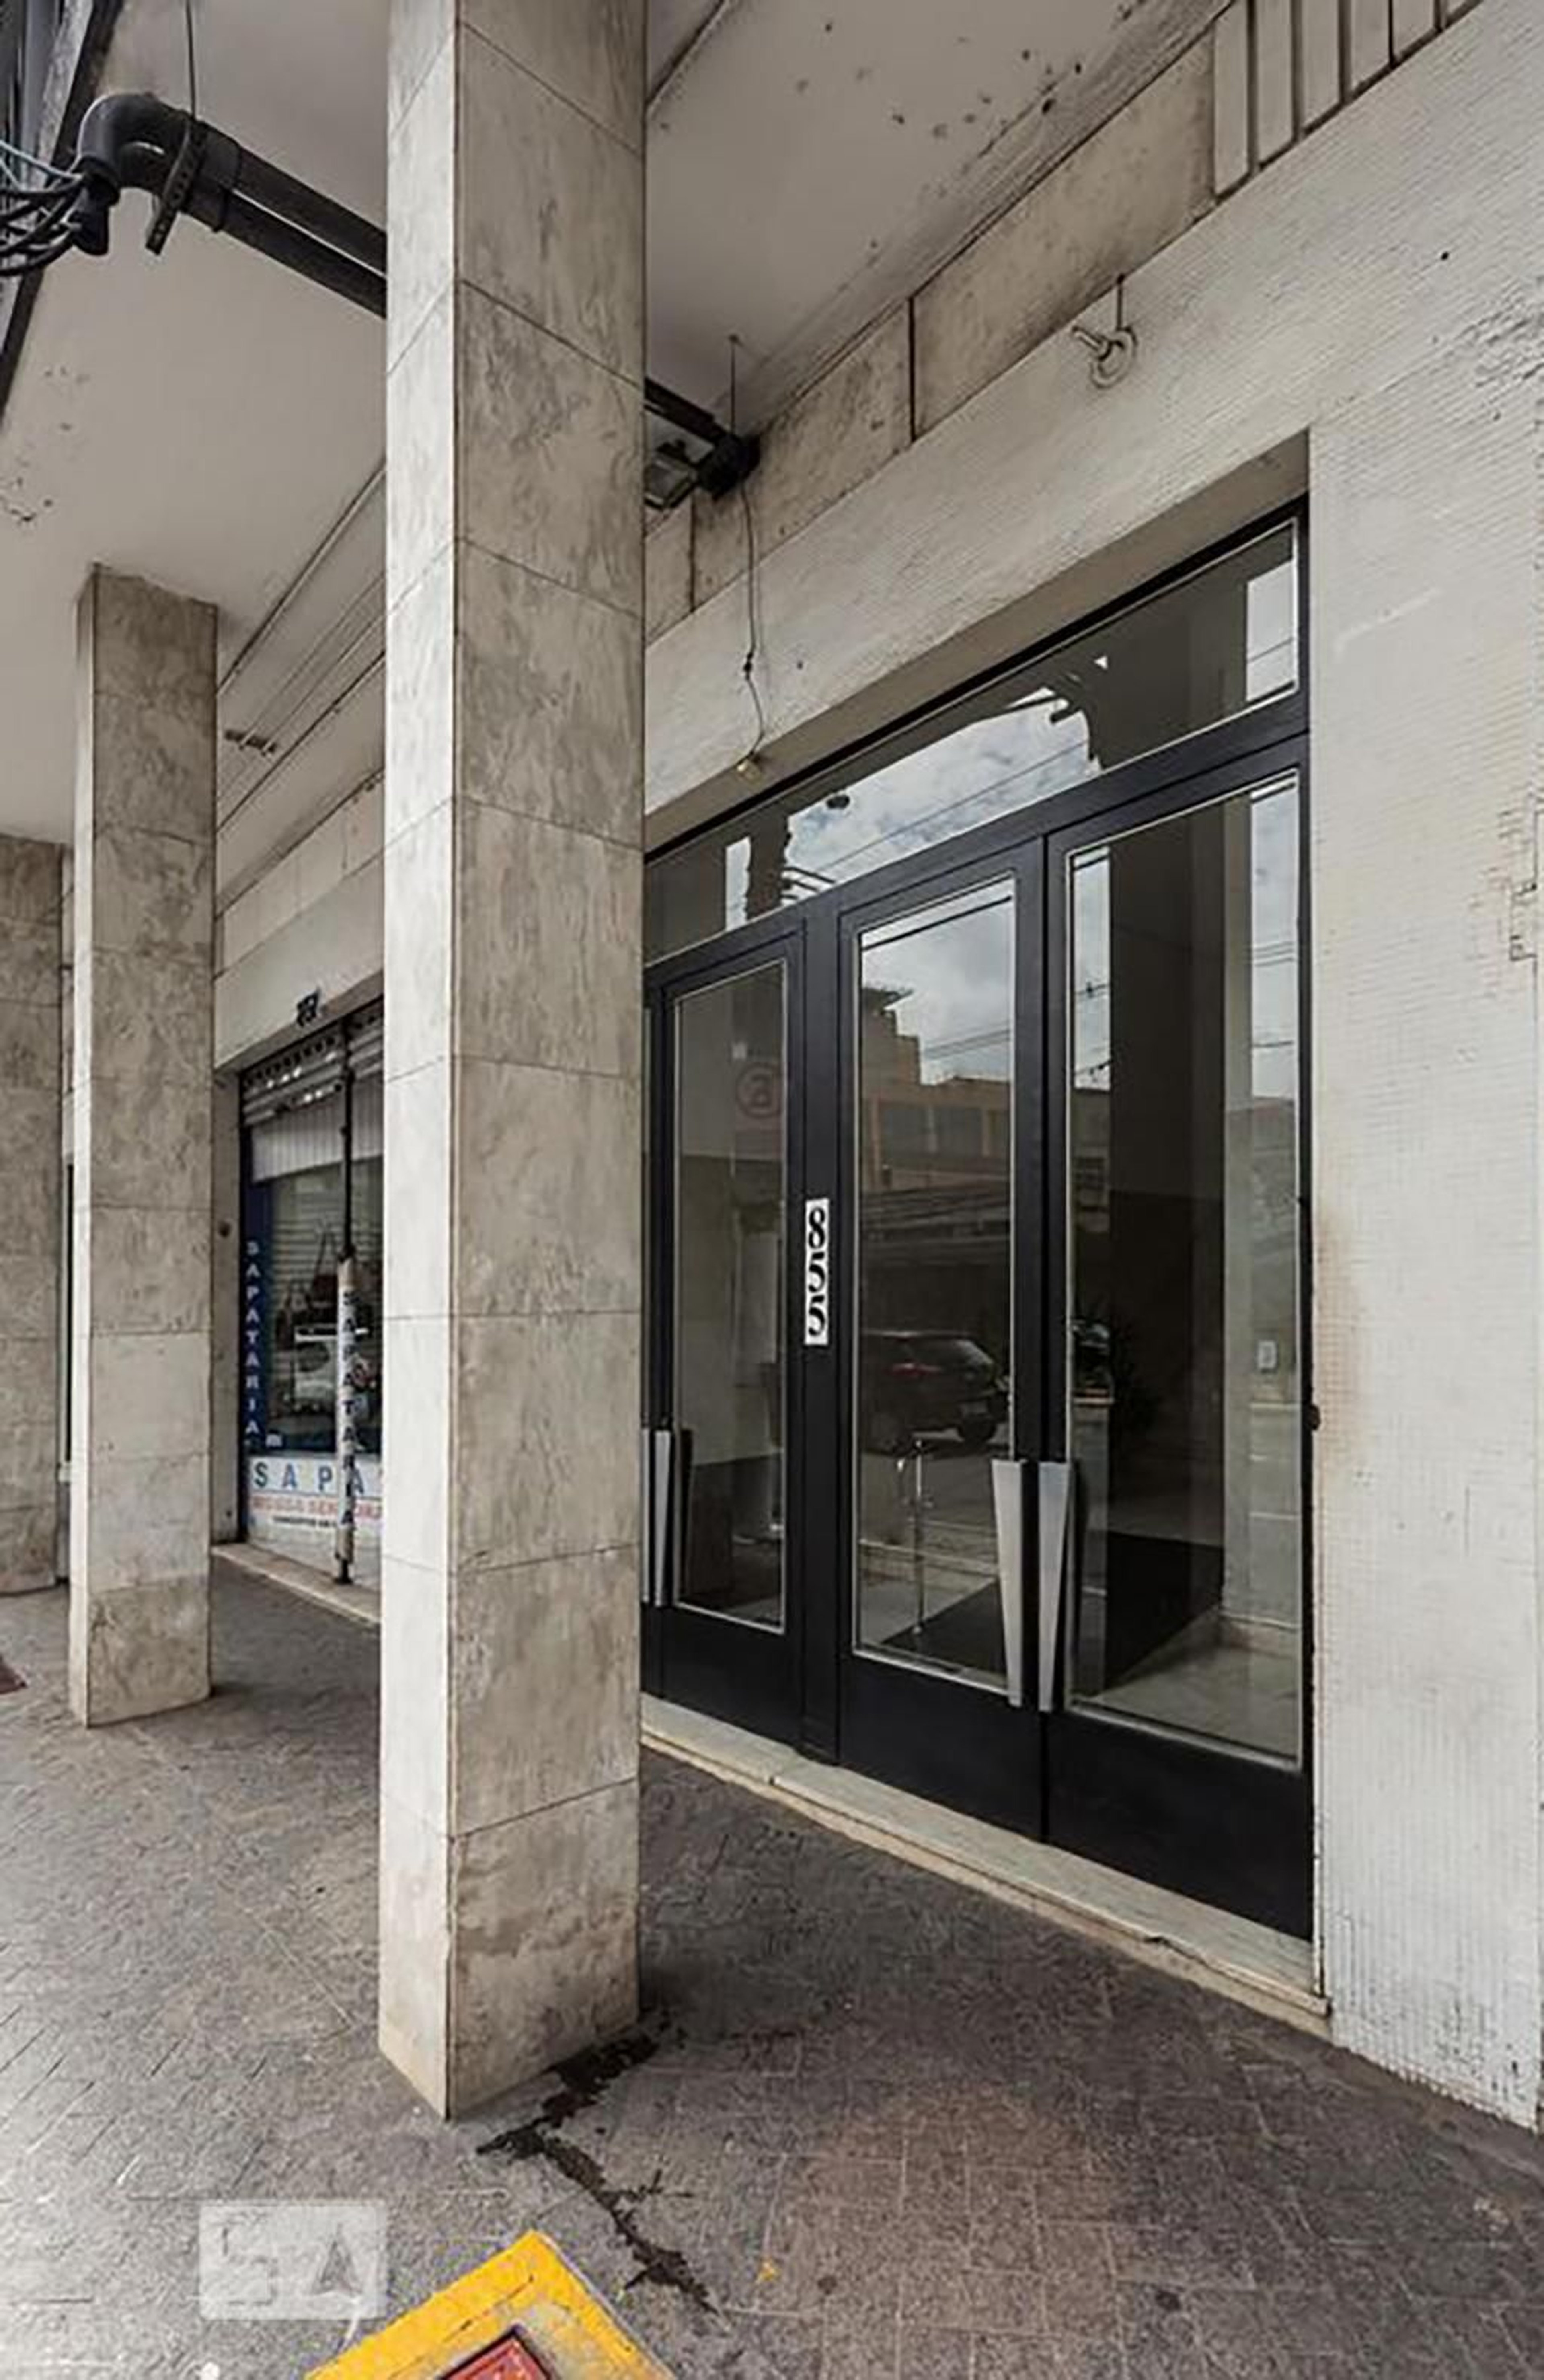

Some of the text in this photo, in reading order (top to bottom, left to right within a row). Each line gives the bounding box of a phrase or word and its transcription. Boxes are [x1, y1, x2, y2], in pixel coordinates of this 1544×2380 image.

[808, 1208, 825, 1336] 855
[246, 1241, 261, 1434] SAPATARIA
[254, 1461, 382, 1494] SAPA
